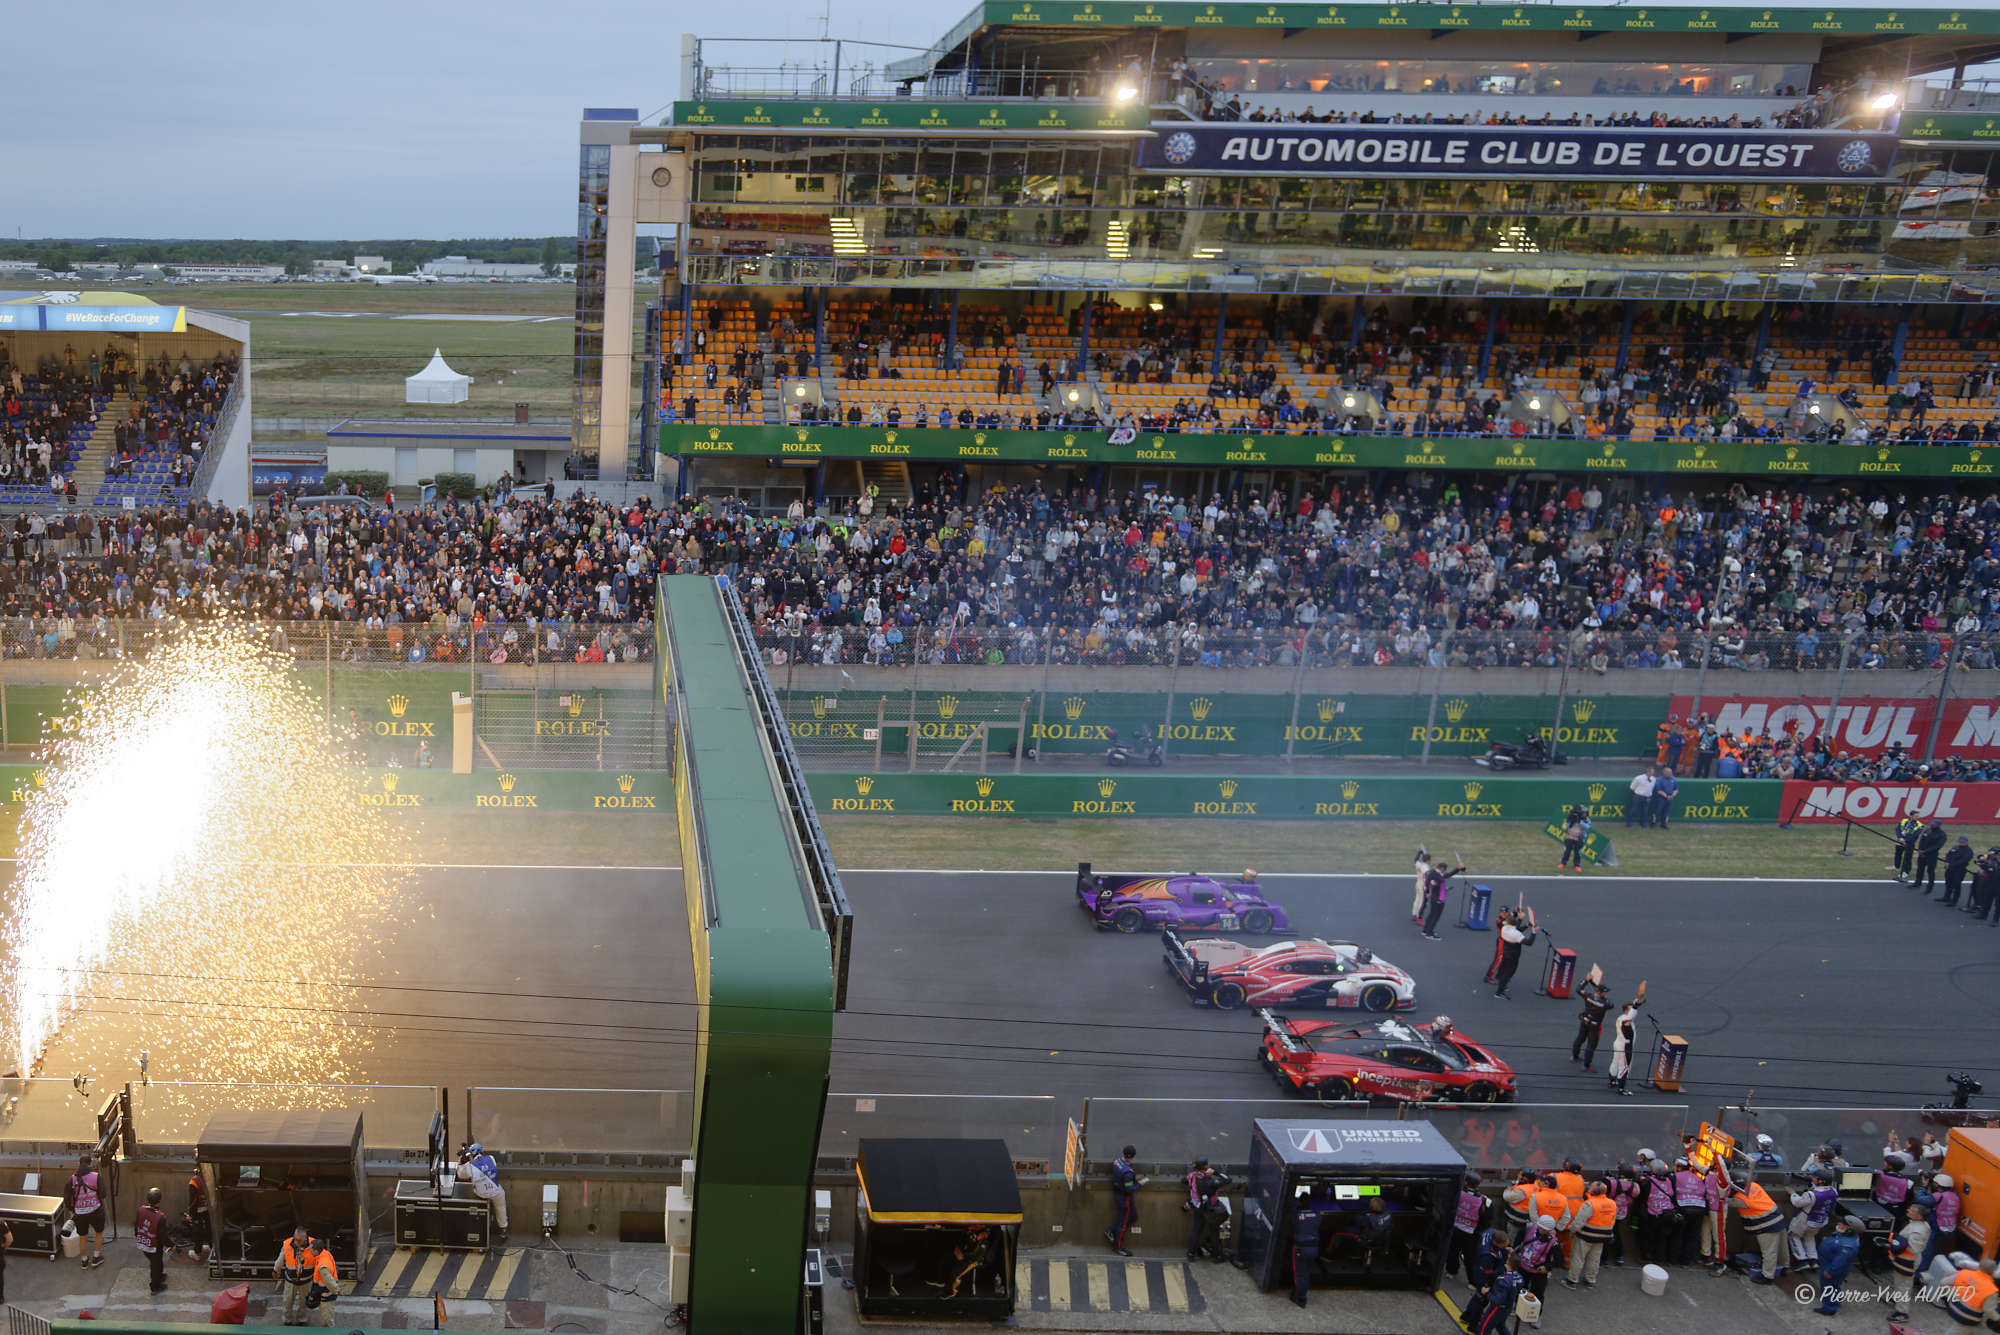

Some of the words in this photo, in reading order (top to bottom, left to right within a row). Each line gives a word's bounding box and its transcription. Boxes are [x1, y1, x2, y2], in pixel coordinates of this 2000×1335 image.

[1012, 13, 1040, 21] ROLEX
[1073, 14, 1101, 22] ROLEX
[1134, 15, 1162, 23] ROLEX
[1195, 15, 1223, 24] ROLEX
[1256, 16, 1284, 24] ROLEX
[1317, 17, 1344, 25] ROLEX
[1378, 17, 1406, 25] ROLEX
[1440, 17, 1468, 26] ROLEX
[1502, 18, 1530, 26] ROLEX
[1564, 19, 1592, 27] ROLEX
[1626, 20, 1654, 28] ROLEX
[1688, 20, 1717, 29] ROLEX
[1750, 21, 1779, 29] ROLEX
[1813, 21, 1840, 29] ROLEX
[1876, 22, 1904, 30] ROLEX
[743, 115, 771, 124] ROLEX
[802, 117, 830, 125] ROLEX
[860, 117, 888, 125] ROLEX
[1037, 119, 1067, 127] ROLEX
[1095, 119, 1125, 127] ROLEX
[1912, 128, 1941, 136] ROLEX
[1221, 137, 1471, 165] AUTOMOBILE
[1480, 140, 1587, 165] CLUB
[1593, 143, 1646, 166] DE
[1656, 144, 1814, 168] L'OUEST
[66, 312, 161, 325] #WeRaceForChange
[694, 441, 733, 451] ROLEX
[782, 443, 821, 453] ROLEX
[870, 444, 909, 454] ROLEX
[960, 446, 998, 456] ROLEX
[1048, 447, 1086, 457] ROLEX
[1137, 449, 1176, 460] ROLEX
[1226, 451, 1266, 461] ROLEX
[1316, 453, 1355, 463] ROLEX
[1406, 455, 1445, 465] ROLEX
[1496, 456, 1536, 467] ROLEX
[1586, 457, 1626, 468] ROLEX
[1677, 459, 1718, 469] ROLEX
[1768, 461, 1808, 471] ROLEX
[1860, 462, 1900, 472] ROLEX
[1952, 463, 1992, 473] ROLEX
[1032, 725, 1110, 739] ROLEX
[1158, 726, 1235, 740] ROLEX
[1285, 726, 1362, 741] ROLEX
[1412, 727, 1490, 742] ROLEX
[1540, 728, 1617, 742] ROLEX
[359, 794, 420, 806] ROLEX
[476, 795, 536, 807] ROLEX
[595, 796, 655, 808] ROLEX
[832, 799, 894, 810] ROLEX
[1799, 786, 1960, 818] MOTUL
[952, 800, 1014, 811] ROLEX
[1073, 801, 1134, 813] ROLEX
[1194, 802, 1256, 814] ROLEX
[1316, 803, 1377, 815] ROLEX
[1438, 804, 1501, 816] ROLEX
[1562, 805, 1624, 816] RLEX
[1685, 806, 1748, 817] ROLEX
[1341, 1129, 1420, 1138] UNITED
